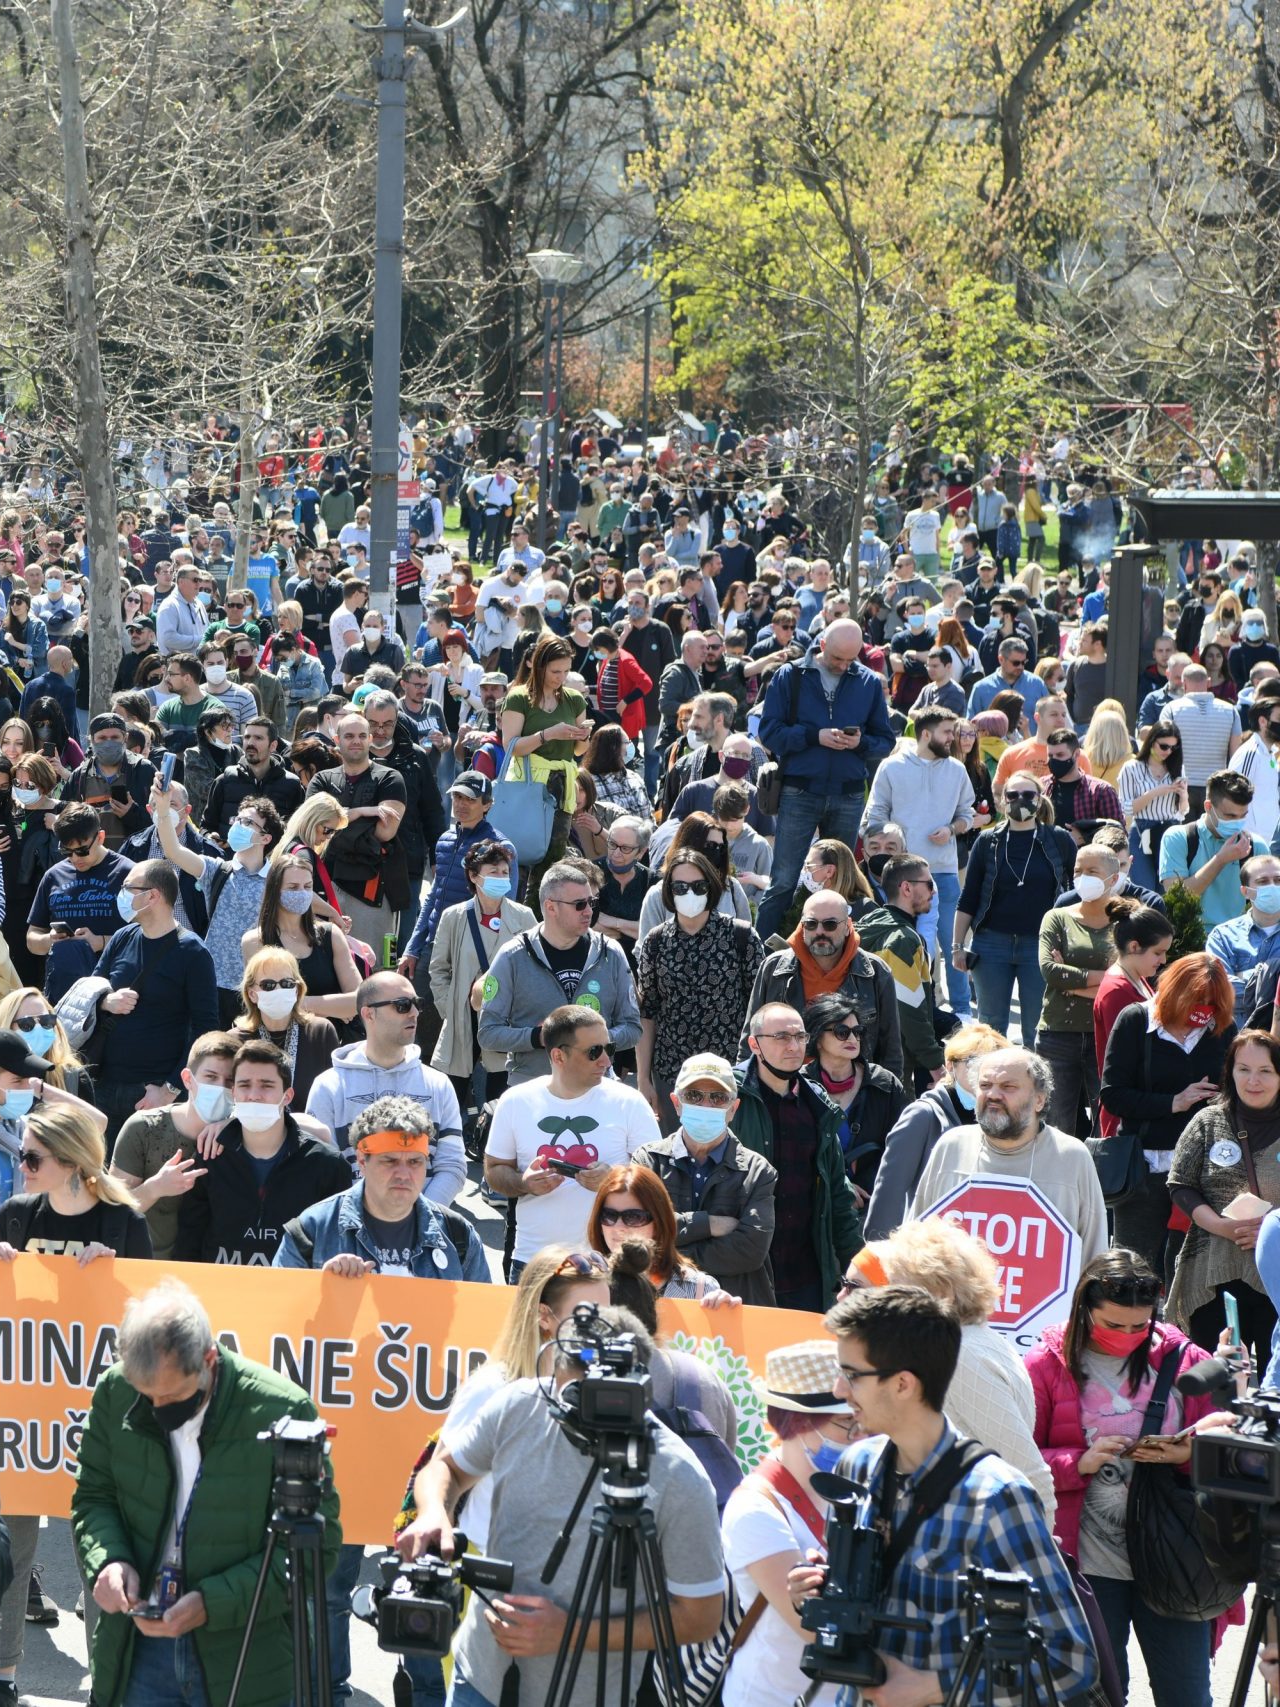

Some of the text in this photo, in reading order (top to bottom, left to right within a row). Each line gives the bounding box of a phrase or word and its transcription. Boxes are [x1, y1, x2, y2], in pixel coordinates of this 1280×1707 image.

[89, 878, 109, 888] WEAR
[49, 889, 117, 905] Tom Tailor
[90, 909, 112, 917] STYLE
[243, 1227, 278, 1240] AIR
[273, 1336, 354, 1405] NE
